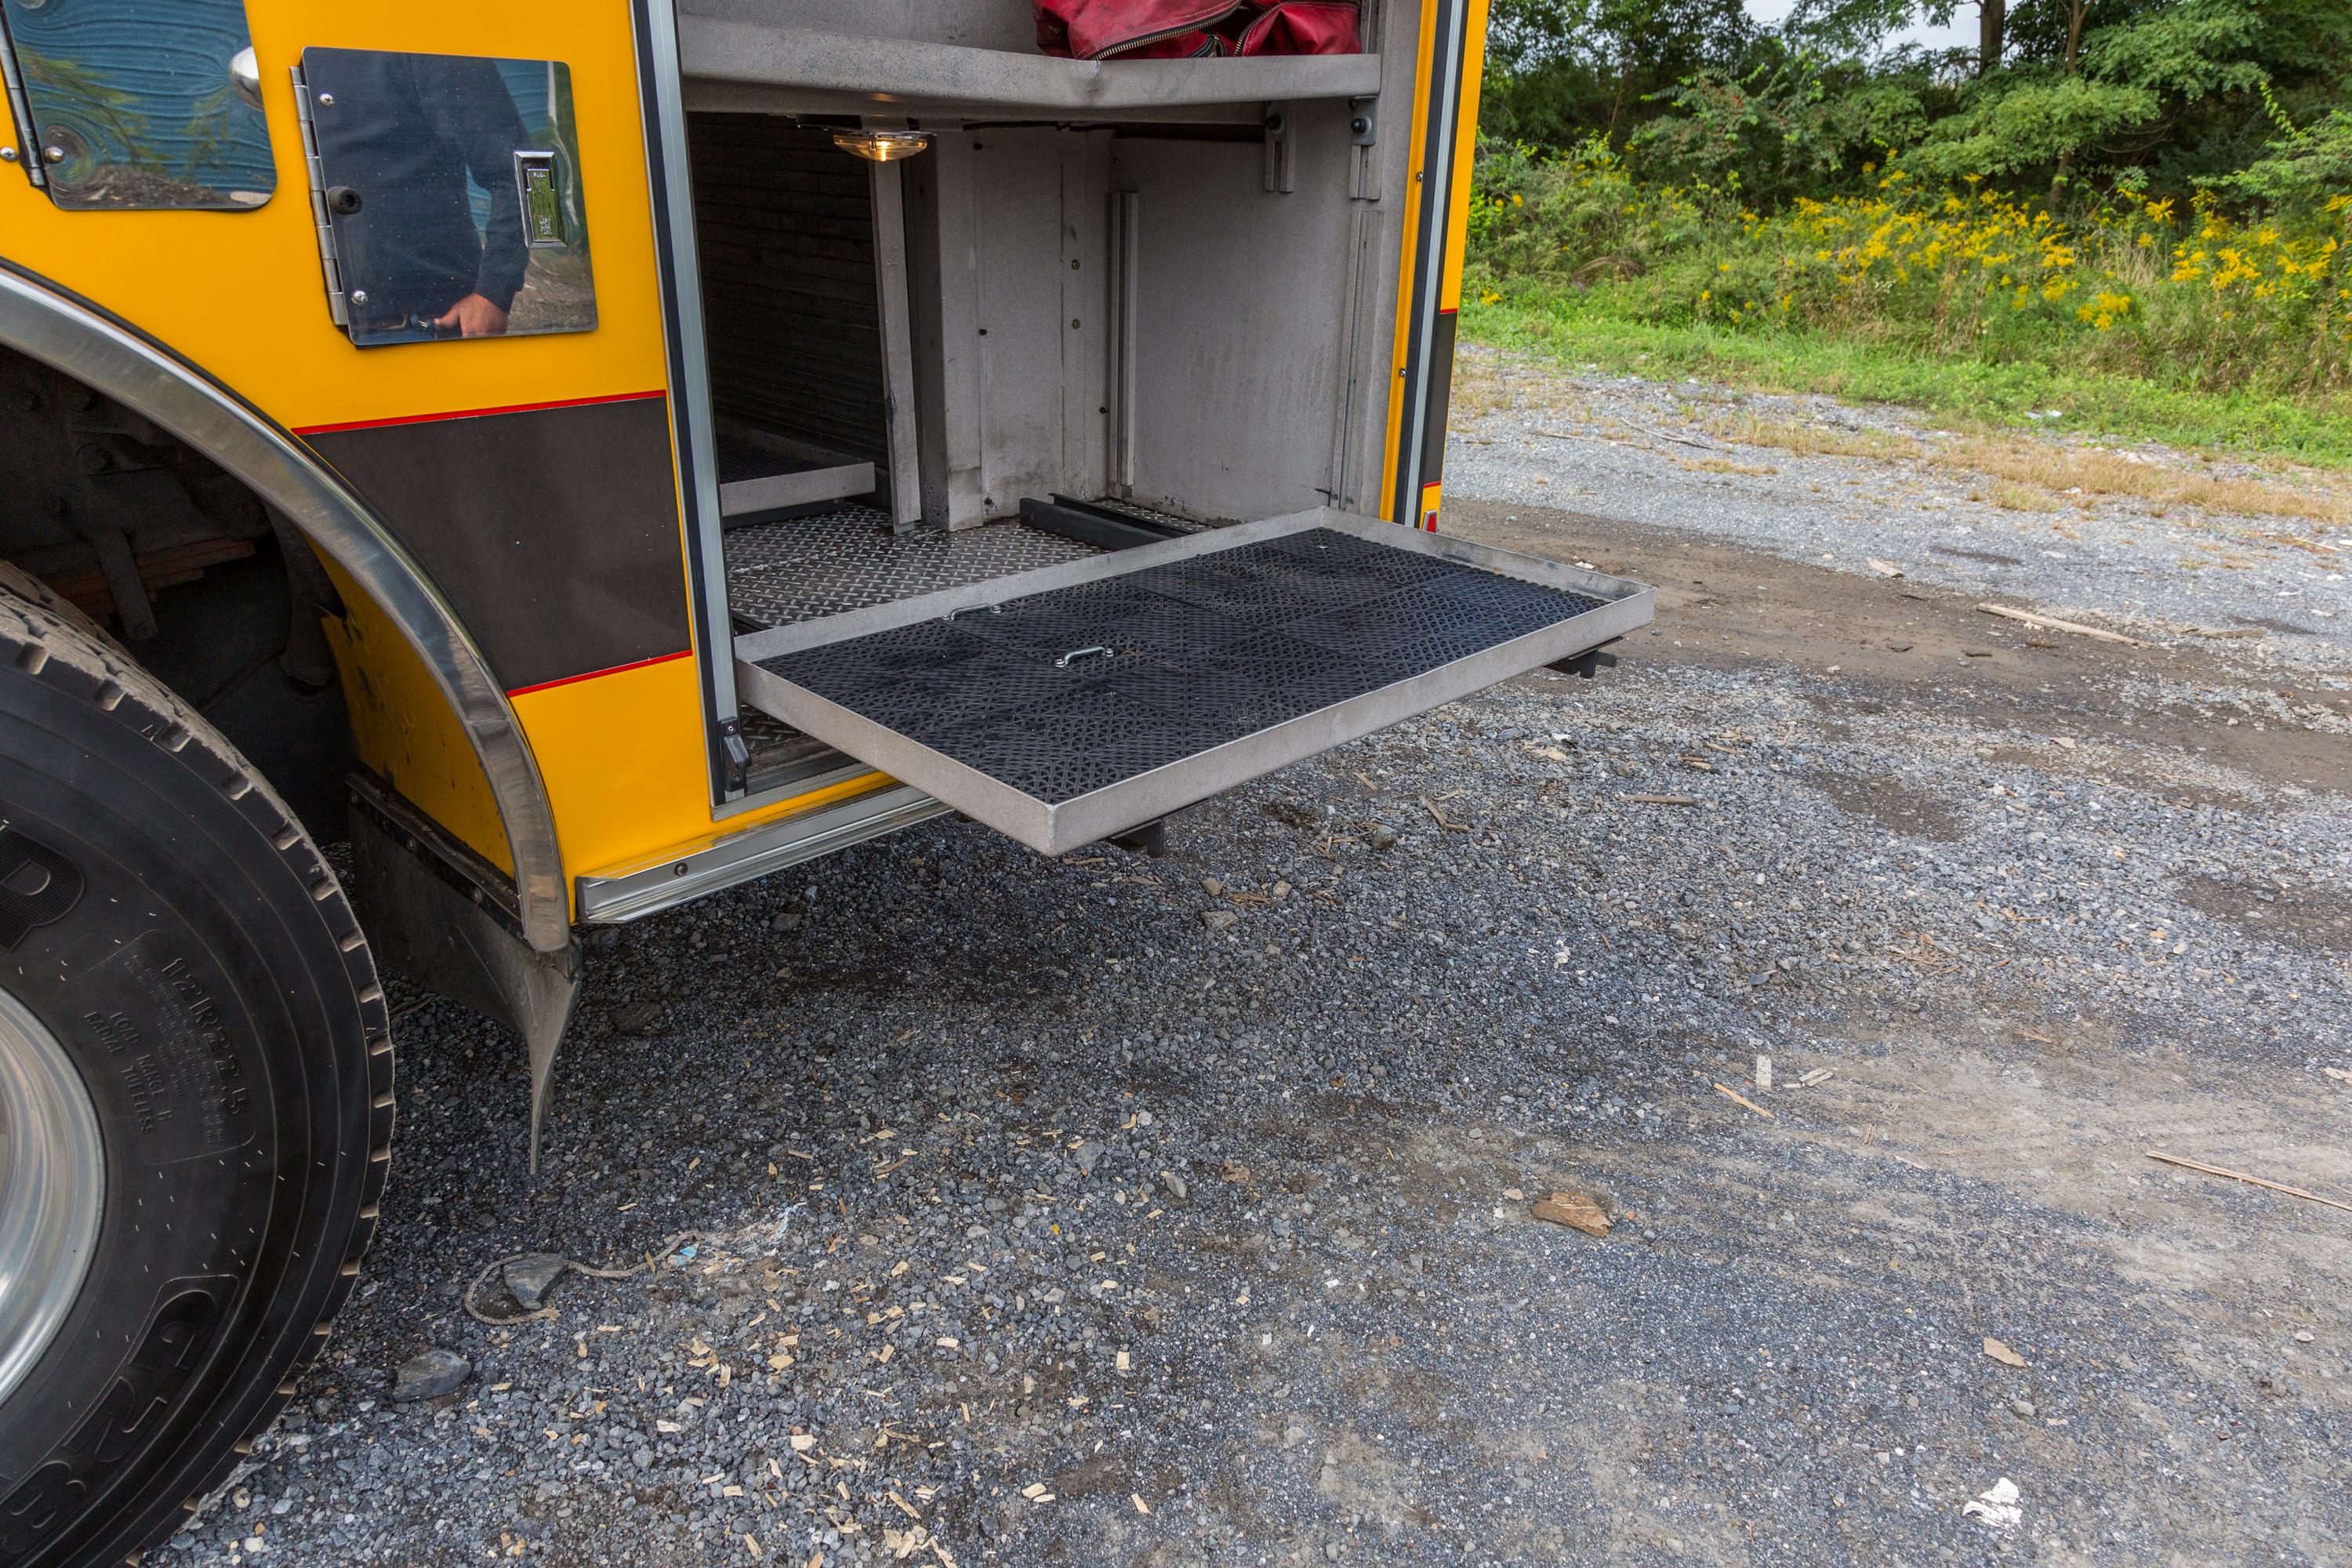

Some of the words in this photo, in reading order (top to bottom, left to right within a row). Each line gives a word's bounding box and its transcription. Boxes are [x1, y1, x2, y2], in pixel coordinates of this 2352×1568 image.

[84, 1011, 123, 1054] RADIAL
[121, 1065, 156, 1135] TUBELESS
[109, 1011, 140, 1044] LOAD
[136, 1054, 167, 1099] RANGE
[162, 957, 248, 1115] 12R22.5
